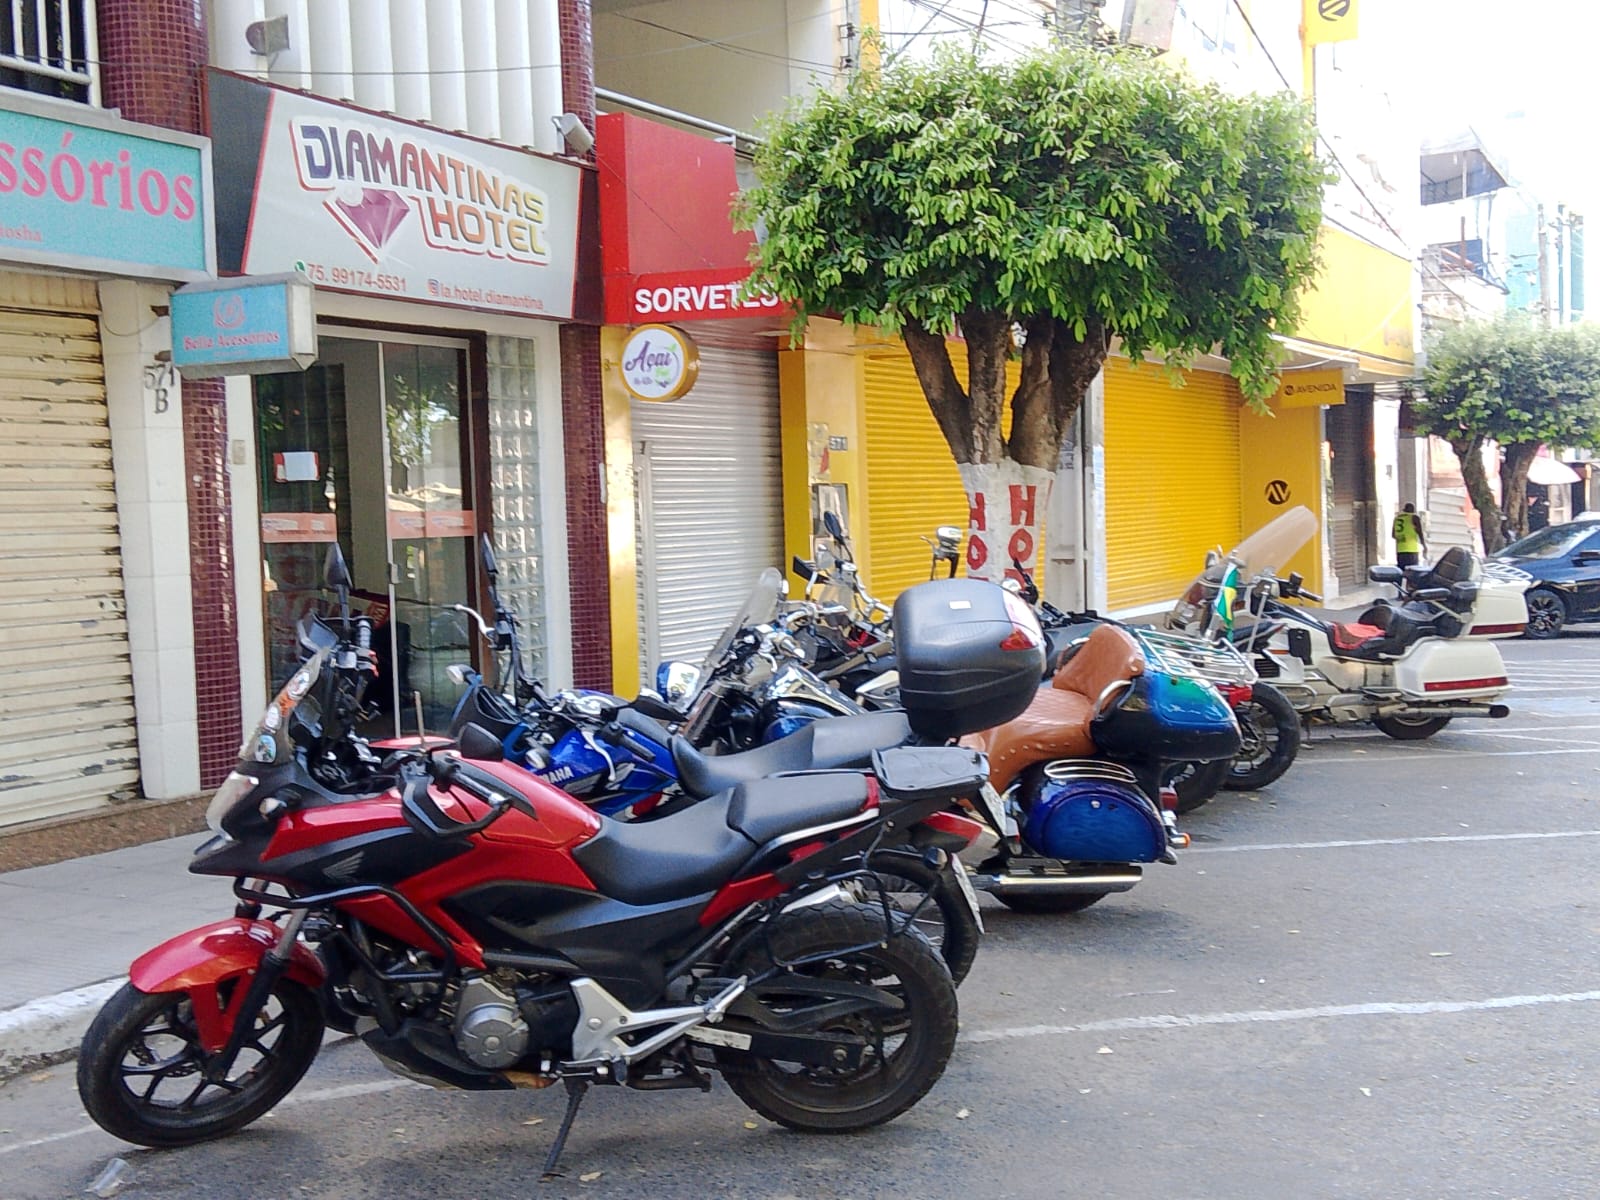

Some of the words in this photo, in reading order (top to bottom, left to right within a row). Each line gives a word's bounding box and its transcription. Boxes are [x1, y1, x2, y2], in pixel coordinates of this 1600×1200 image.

[0, 131, 196, 221] ssórios
[300, 125, 544, 225] DIAMANTINAS
[428, 196, 546, 255] HOTEL
[332, 267, 407, 292] 99174-5531
[634, 283, 779, 314] SORVETES
[144, 364, 175, 390] 571
[1296, 383, 1337, 394] AVENIDA
[154, 388, 168, 414] B
